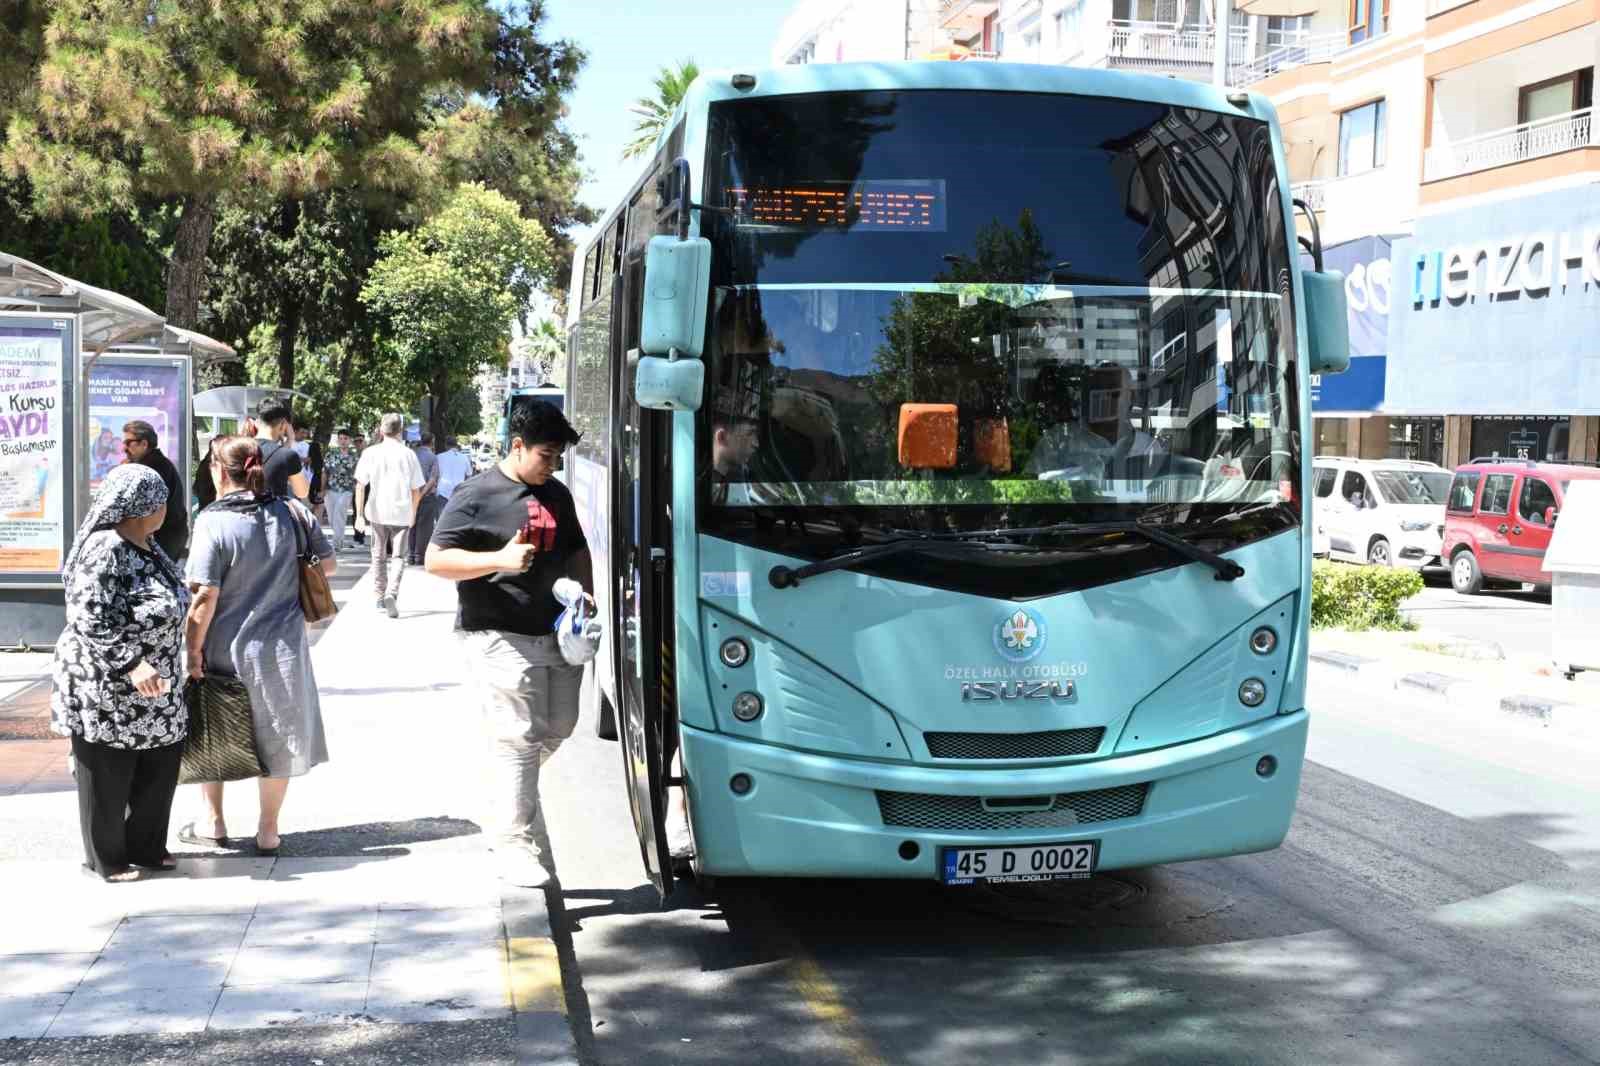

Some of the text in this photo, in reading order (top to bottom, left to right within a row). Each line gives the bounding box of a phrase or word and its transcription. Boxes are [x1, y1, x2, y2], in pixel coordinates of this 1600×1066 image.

[9, 393, 55, 412] Kursu
[944, 661, 1088, 680] ÖZEL HALK OTOBÜSÜ
[961, 680, 1077, 702] ISUZU
[958, 848, 1088, 875] 45 D 0002
